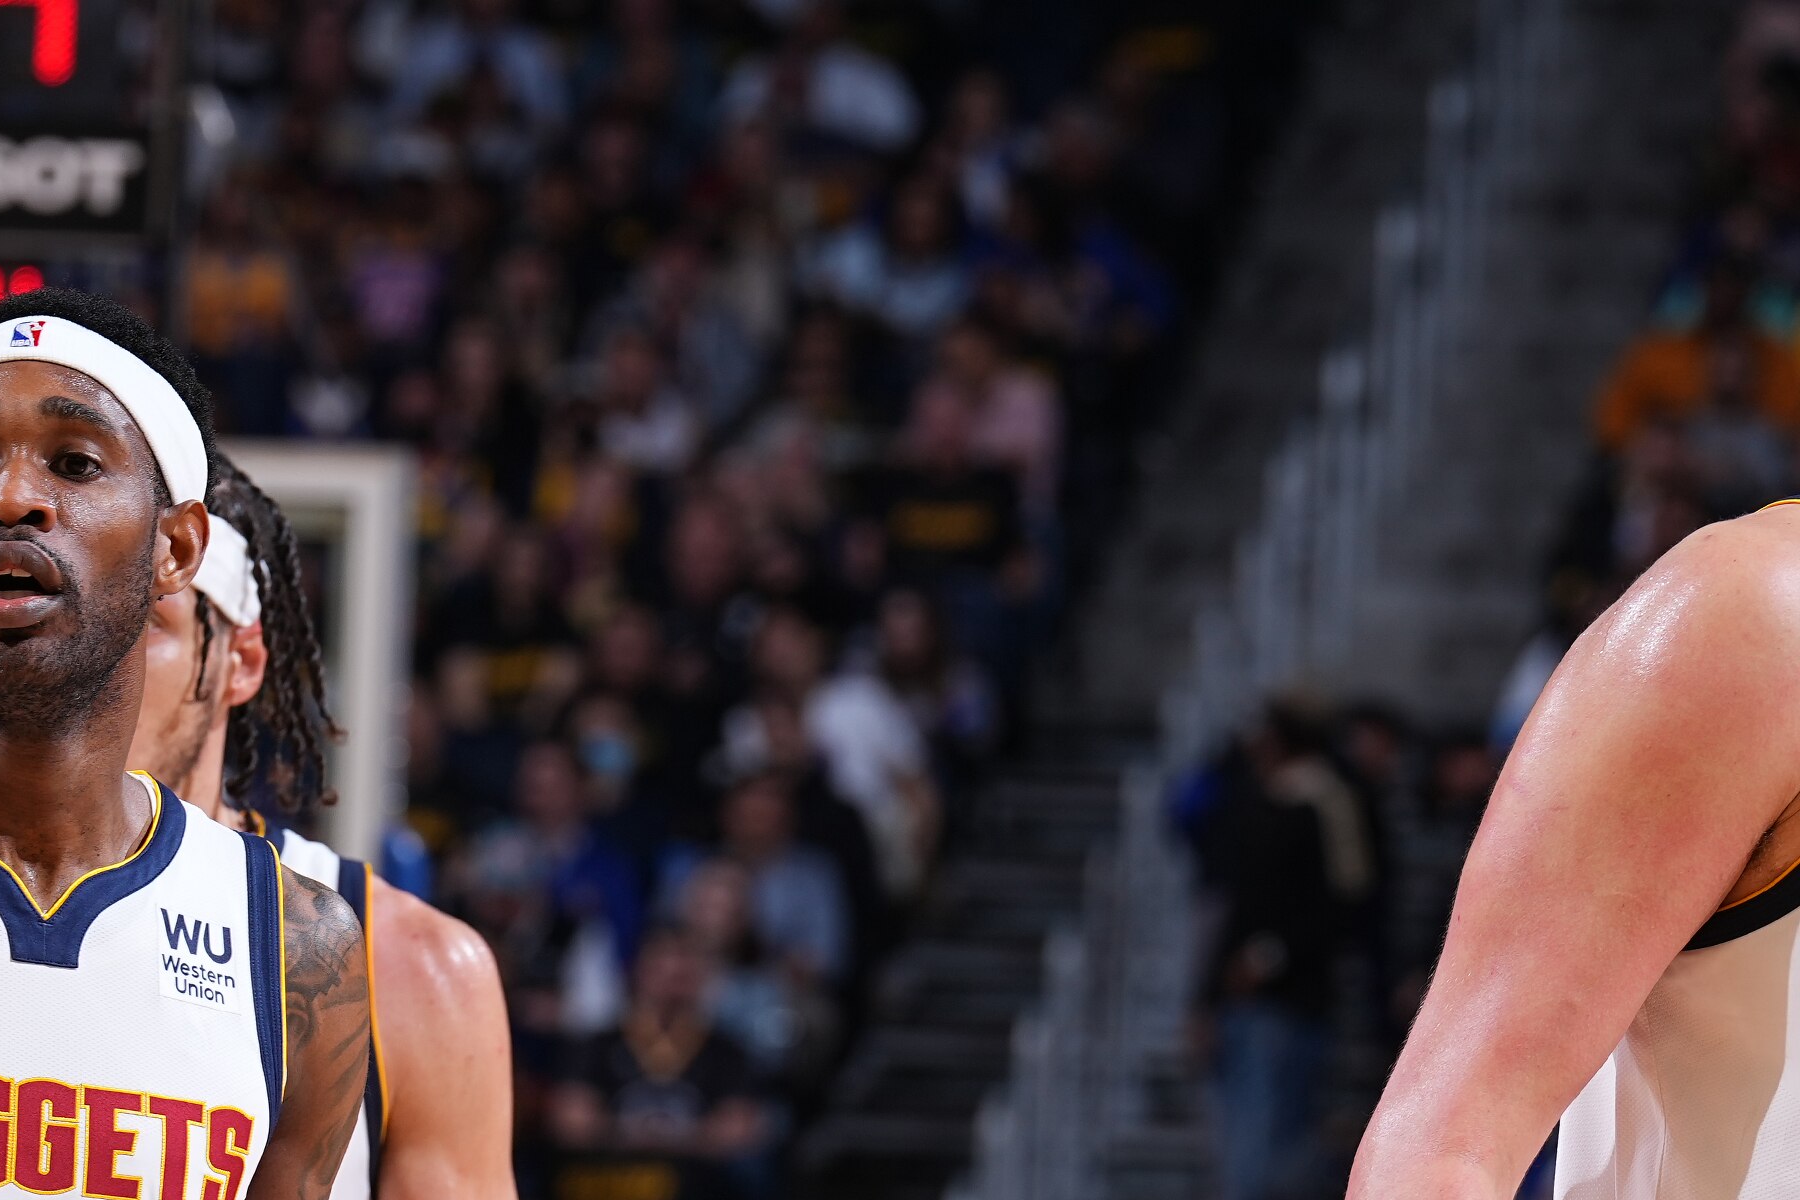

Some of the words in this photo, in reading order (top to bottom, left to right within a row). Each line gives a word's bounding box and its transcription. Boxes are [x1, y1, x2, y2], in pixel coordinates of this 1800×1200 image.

[160, 907, 232, 964] WU
[161, 953, 235, 988] Western
[175, 976, 225, 1004] Union
